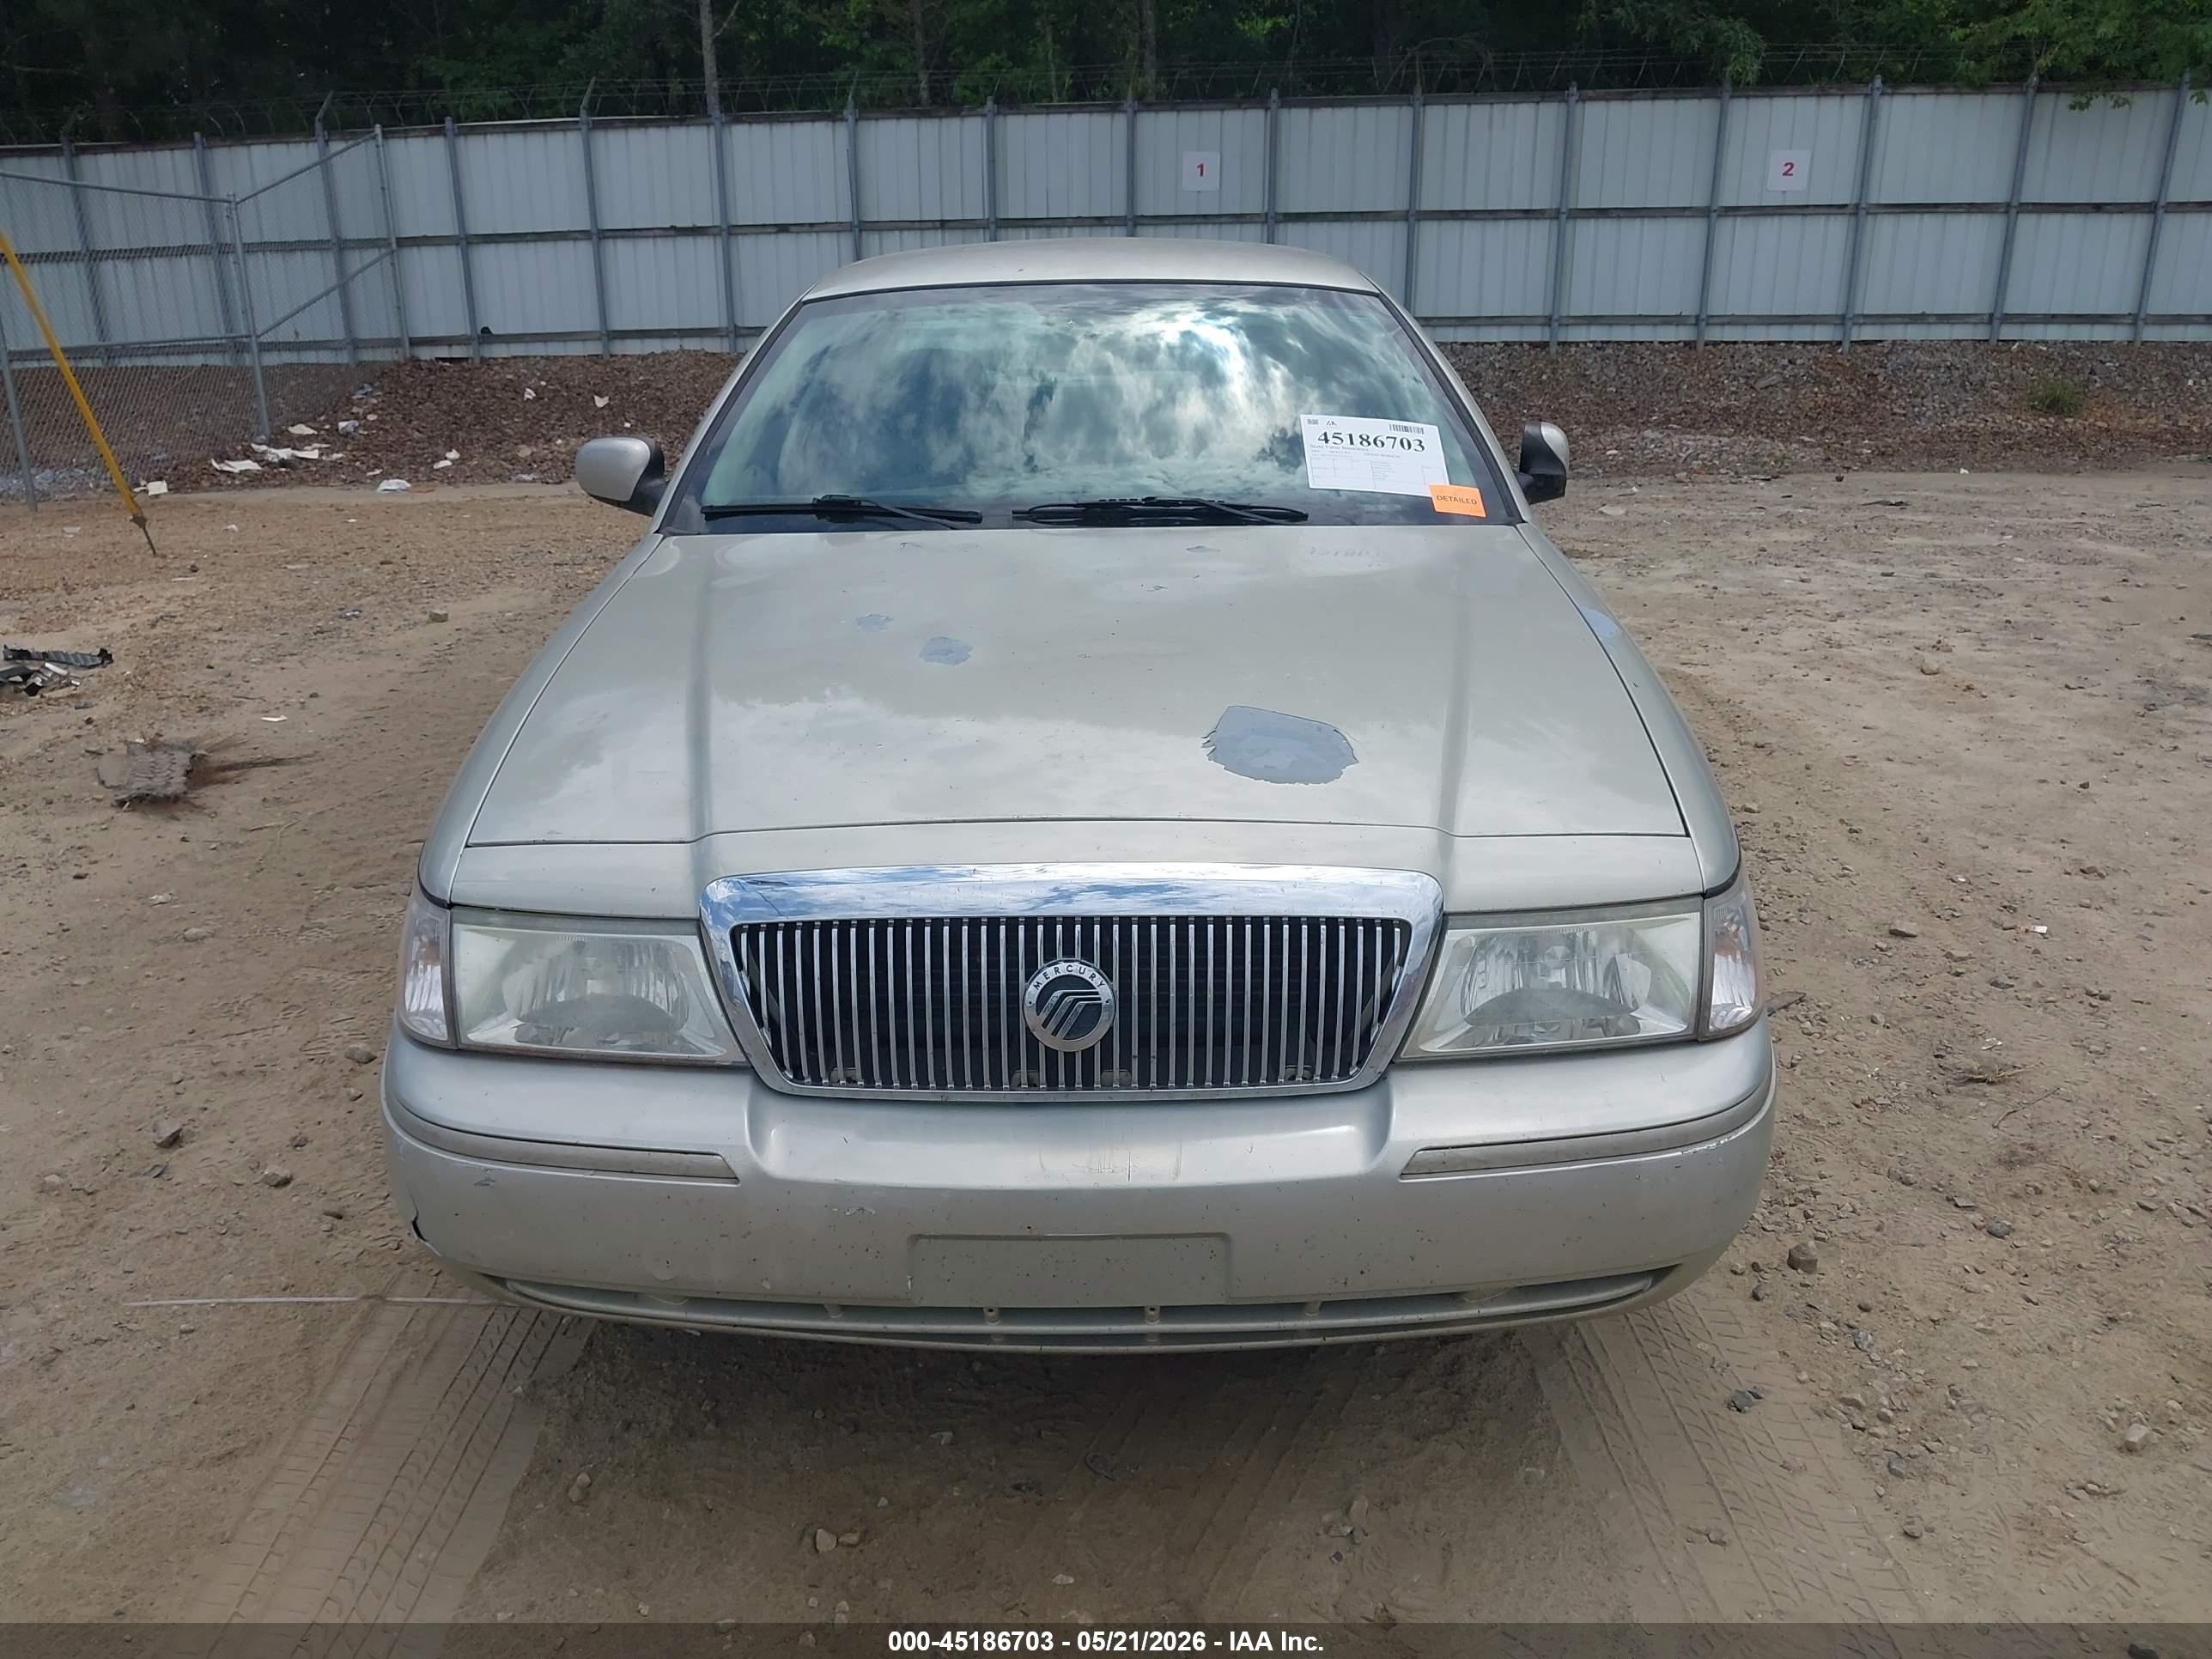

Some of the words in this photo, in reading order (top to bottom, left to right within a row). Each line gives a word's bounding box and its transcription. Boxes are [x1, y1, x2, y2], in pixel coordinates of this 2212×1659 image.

[1196, 163, 1205, 177] 1
[1782, 161, 1795, 177] 2
[1317, 431, 1425, 453] 45186703
[1436, 495, 1477, 506] DETAILED
[1034, 964, 1105, 991] MERCURY
